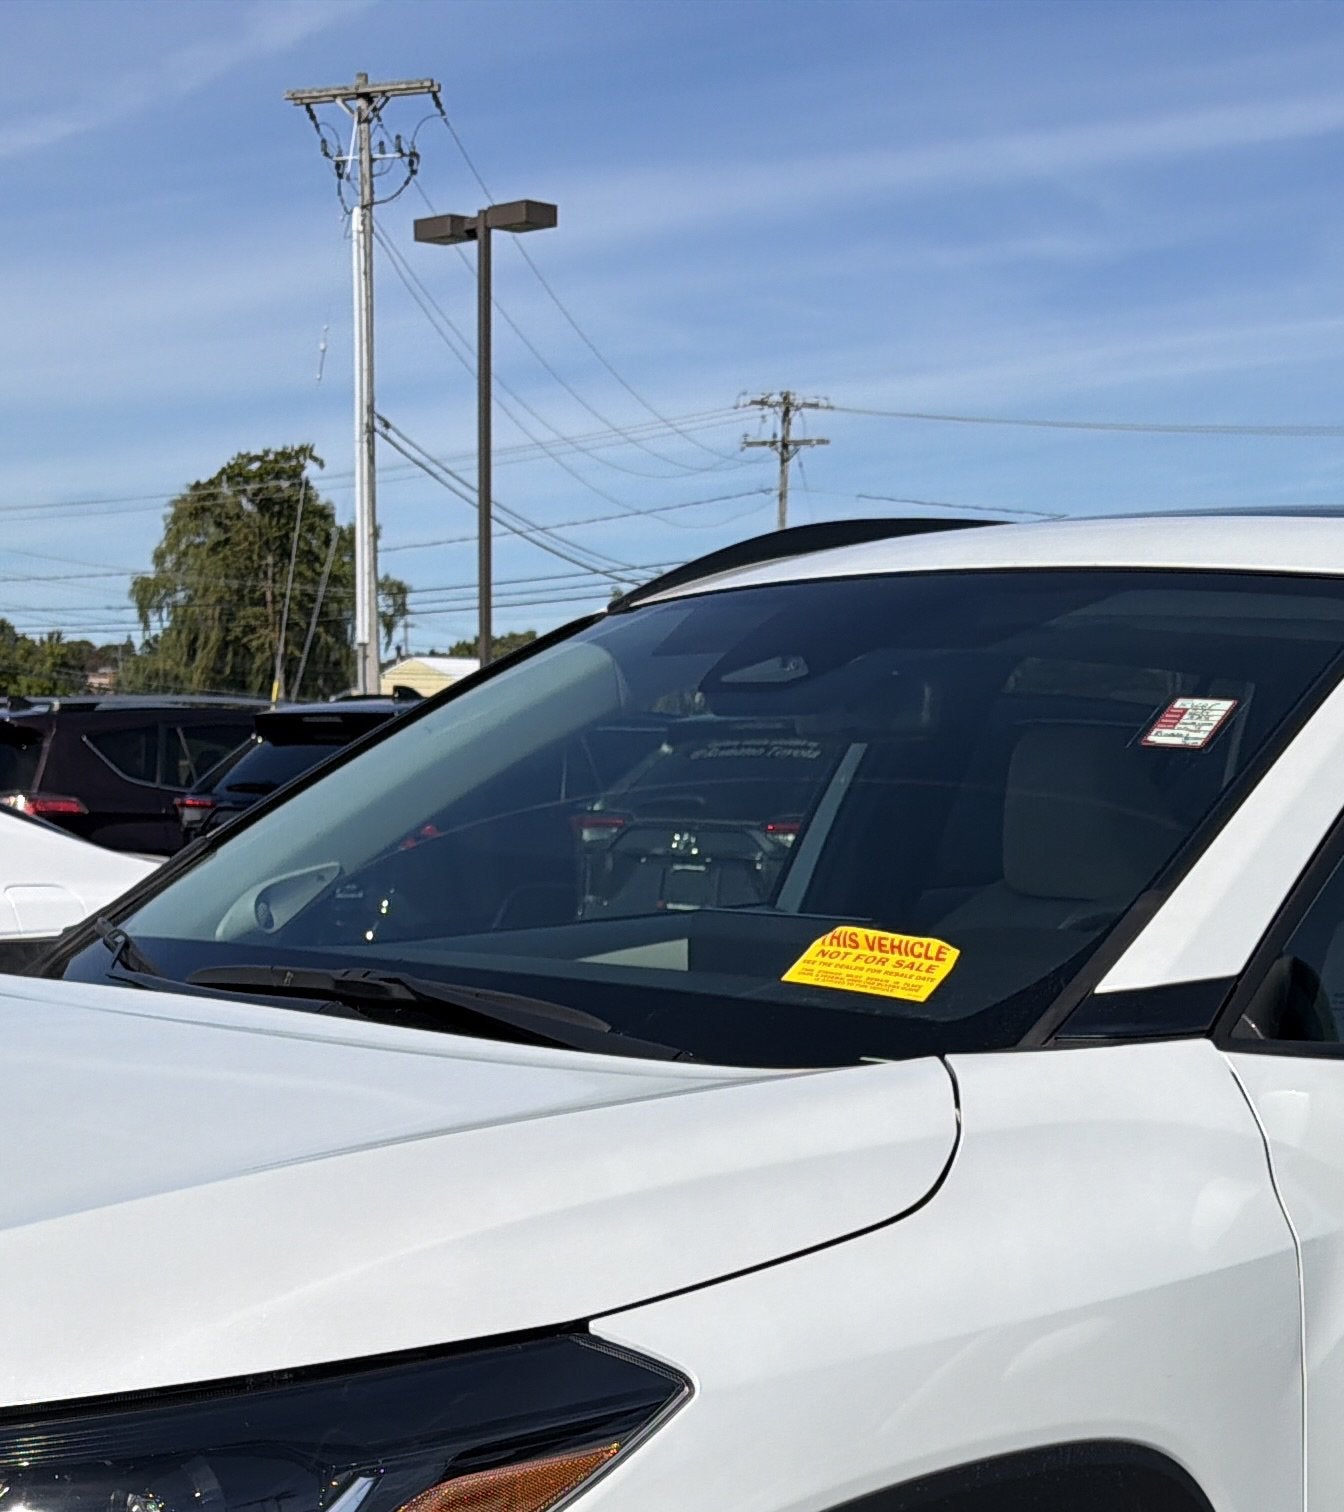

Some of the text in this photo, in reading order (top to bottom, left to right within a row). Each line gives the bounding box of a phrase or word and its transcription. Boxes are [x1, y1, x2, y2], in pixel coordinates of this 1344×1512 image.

[815, 949, 940, 974] NOT FOR SALE
[864, 934, 951, 963] VEHICLE
